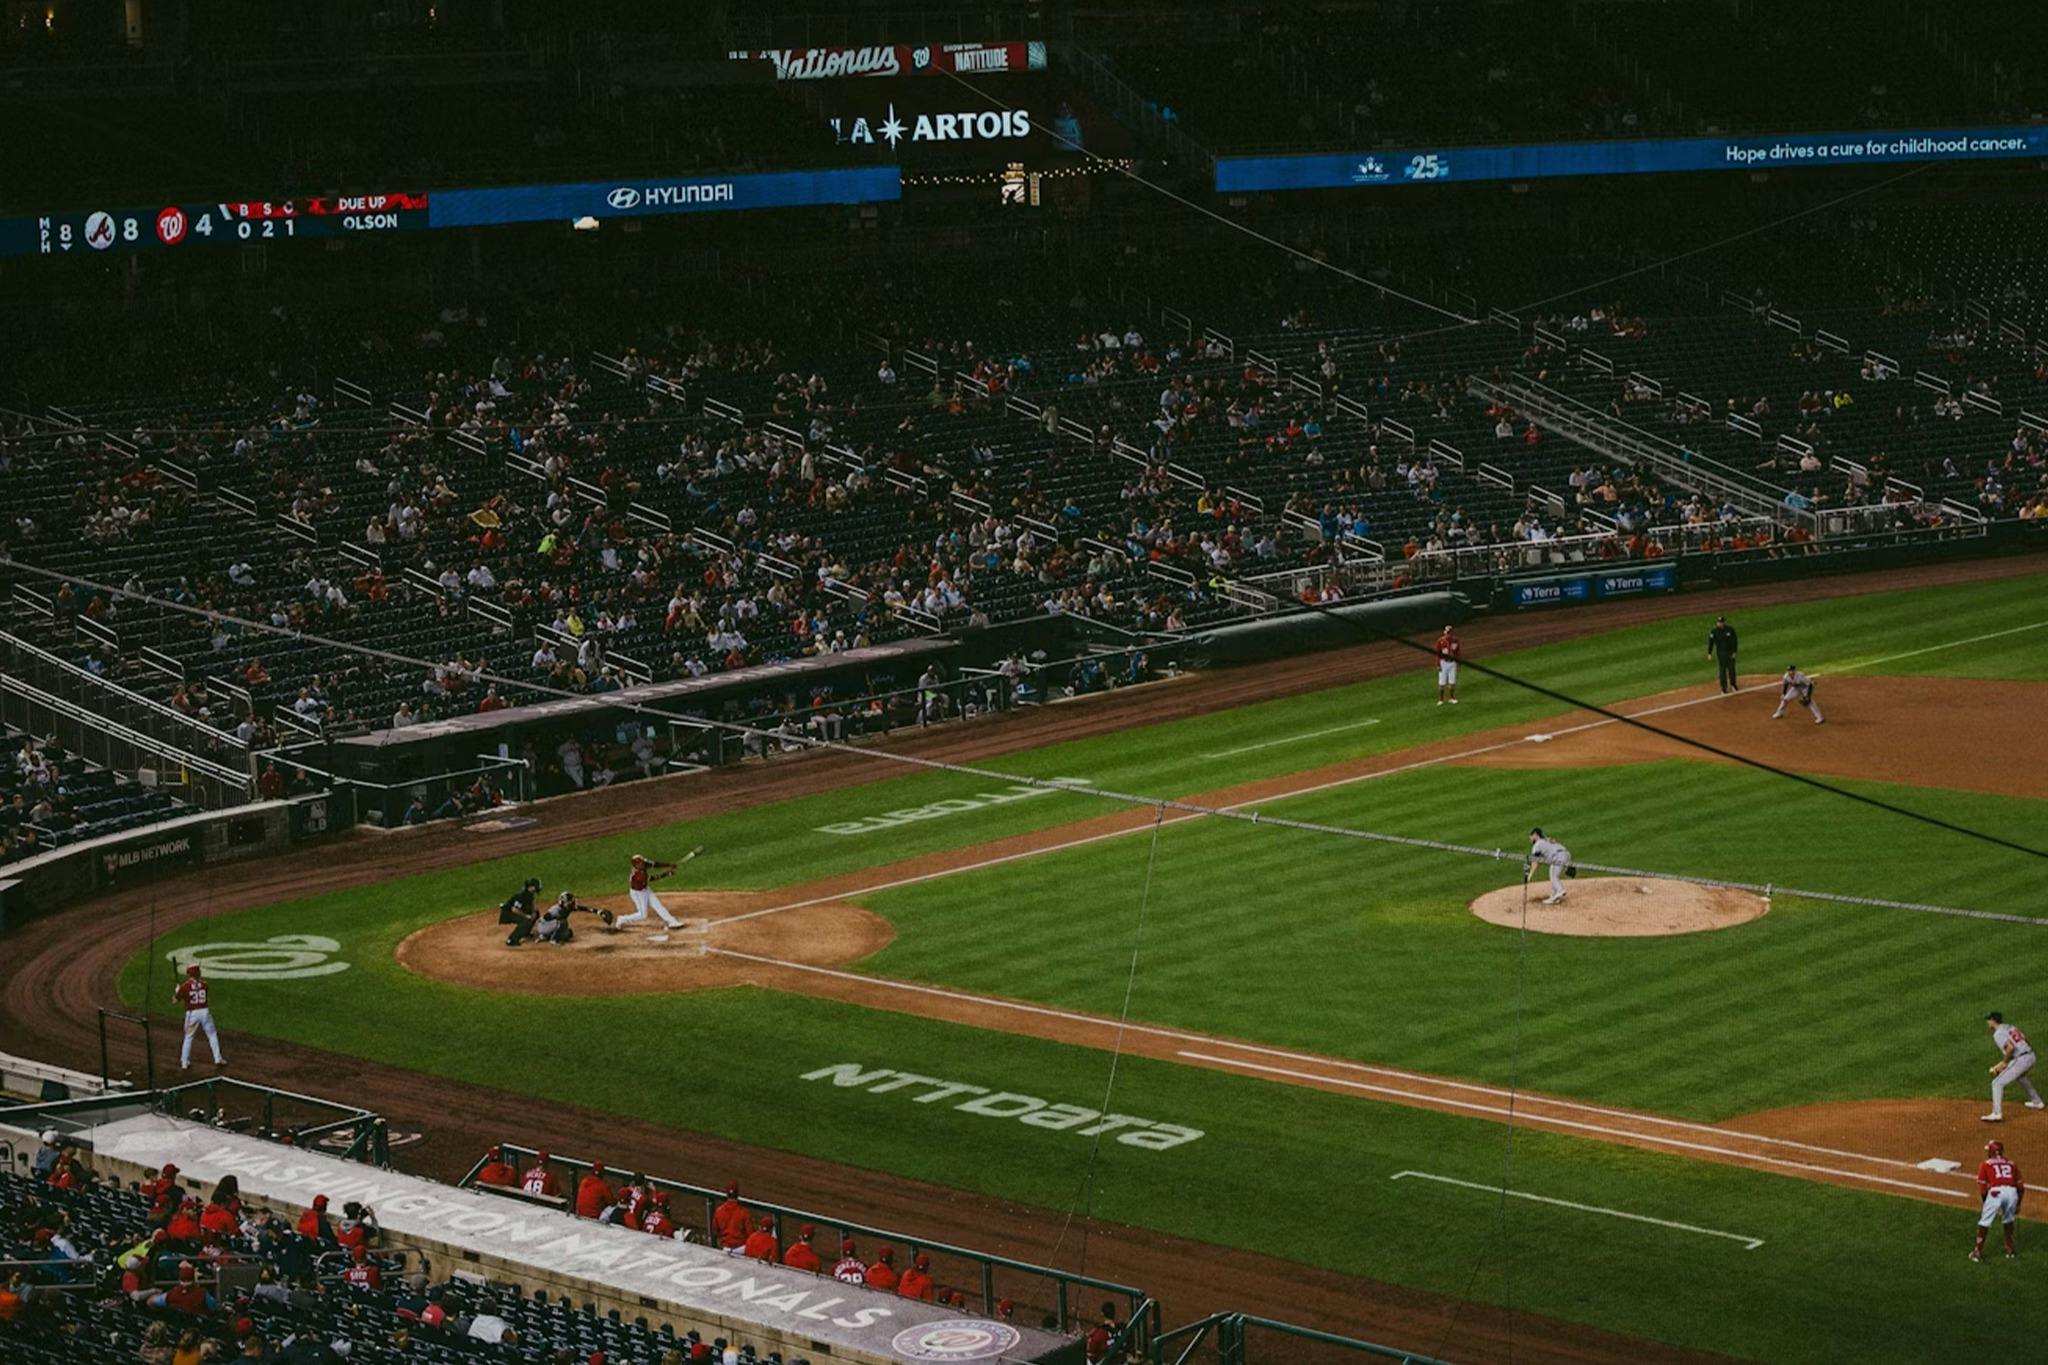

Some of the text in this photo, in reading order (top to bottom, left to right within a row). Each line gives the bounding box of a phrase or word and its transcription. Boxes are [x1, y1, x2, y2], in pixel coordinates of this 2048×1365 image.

[771, 46, 900, 80] Nationals
[954, 47, 1009, 72] NATITUDE
[912, 110, 1031, 141] ARTOIS
[1726, 137, 2027, 164] Hope drives a cure for childhood cancer.
[1412, 155, 1439, 179] 25
[338, 196, 387, 211] DUE UP
[645, 183, 734, 206] HYUNDAI
[240, 204, 249, 216] B
[263, 203, 272, 215] S
[123, 218, 139, 241] 8
[195, 214, 213, 236] 4
[238, 219, 295, 239] 0 2 1
[343, 214, 398, 230] OLSON
[59, 224, 73, 242] 8
[1534, 587, 1560, 598] Terra
[1617, 578, 1643, 589] Terra
[119, 838, 190, 867] MLB NETWORK
[189, 989, 207, 1004] 39
[1992, 1164, 2012, 1178] 12
[523, 1179, 544, 1194] 48
[197, 1147, 893, 1329] WASHINGTON NATIONALS
